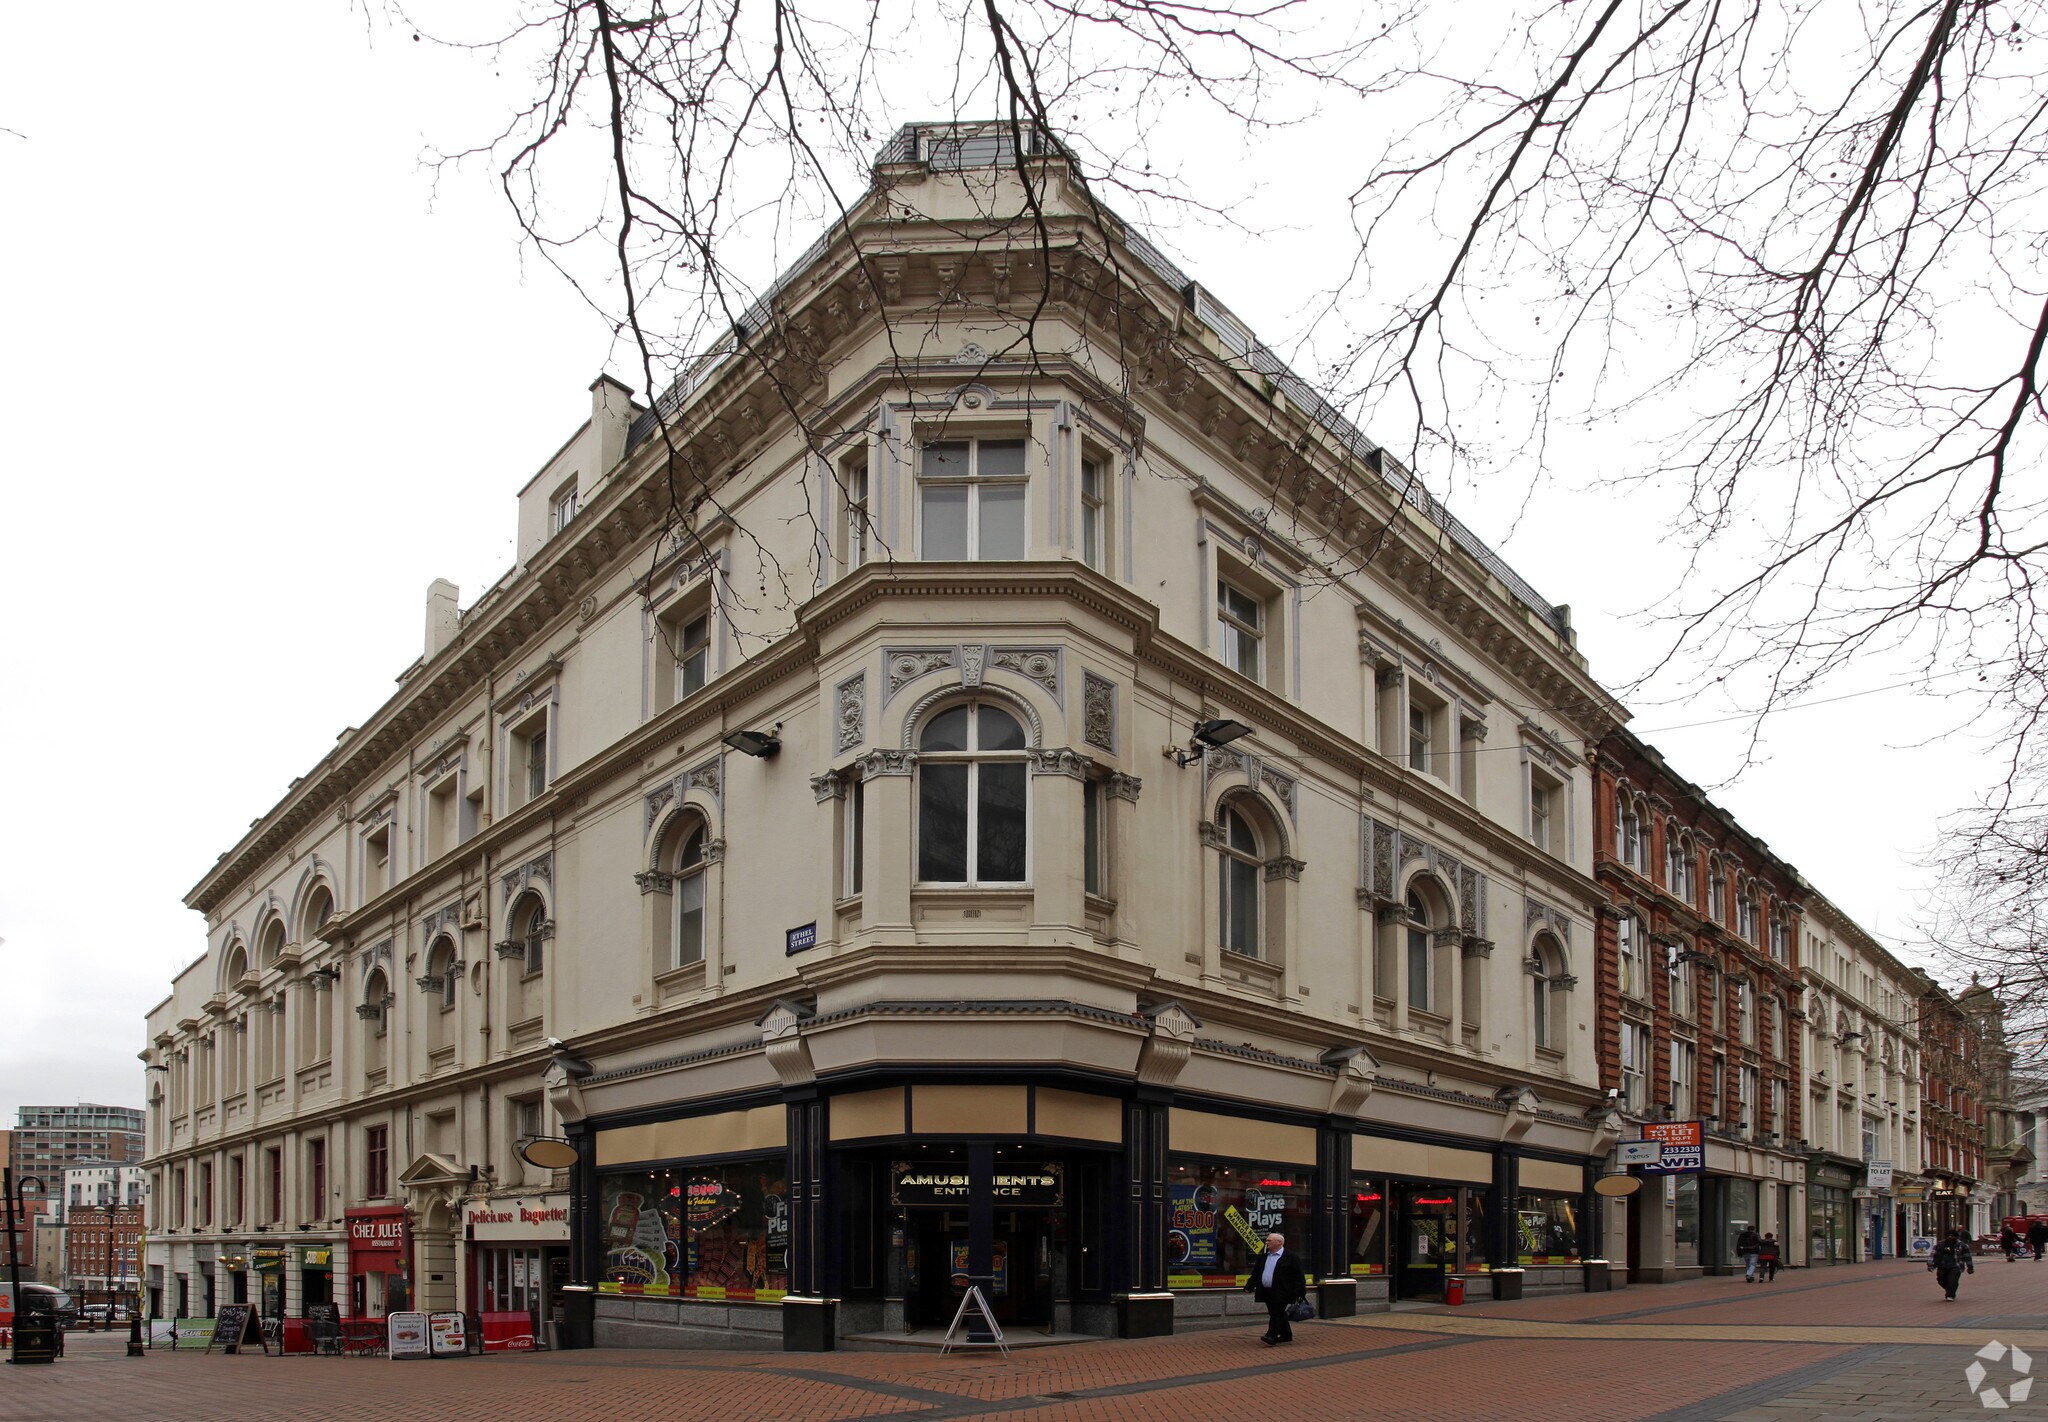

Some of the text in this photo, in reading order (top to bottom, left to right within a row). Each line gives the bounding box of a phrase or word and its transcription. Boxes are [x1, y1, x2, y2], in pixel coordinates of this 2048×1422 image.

[792, 929, 813, 940] ETHEL
[791, 935, 815, 948] STREET
[1672, 1128, 1694, 1136] LET
[1664, 1145, 1700, 1154] 233 2330
[1625, 1152, 1650, 1161] ingeus
[901, 1174, 1055, 1186] AMUSENTS
[934, 1187, 1021, 1196] ENTNCE
[693, 1197, 716, 1206] Fabulous
[1257, 1196, 1285, 1210] Free
[1173, 1210, 1214, 1228] £500
[1248, 1212, 1282, 1228] Plays
[353, 1222, 402, 1238] CHEZ JULES
[1227, 1213, 1259, 1251] MANAGEMENT
[1233, 1211, 1260, 1243] UNDER NEW
[305, 1251, 330, 1265] SUBWAY
